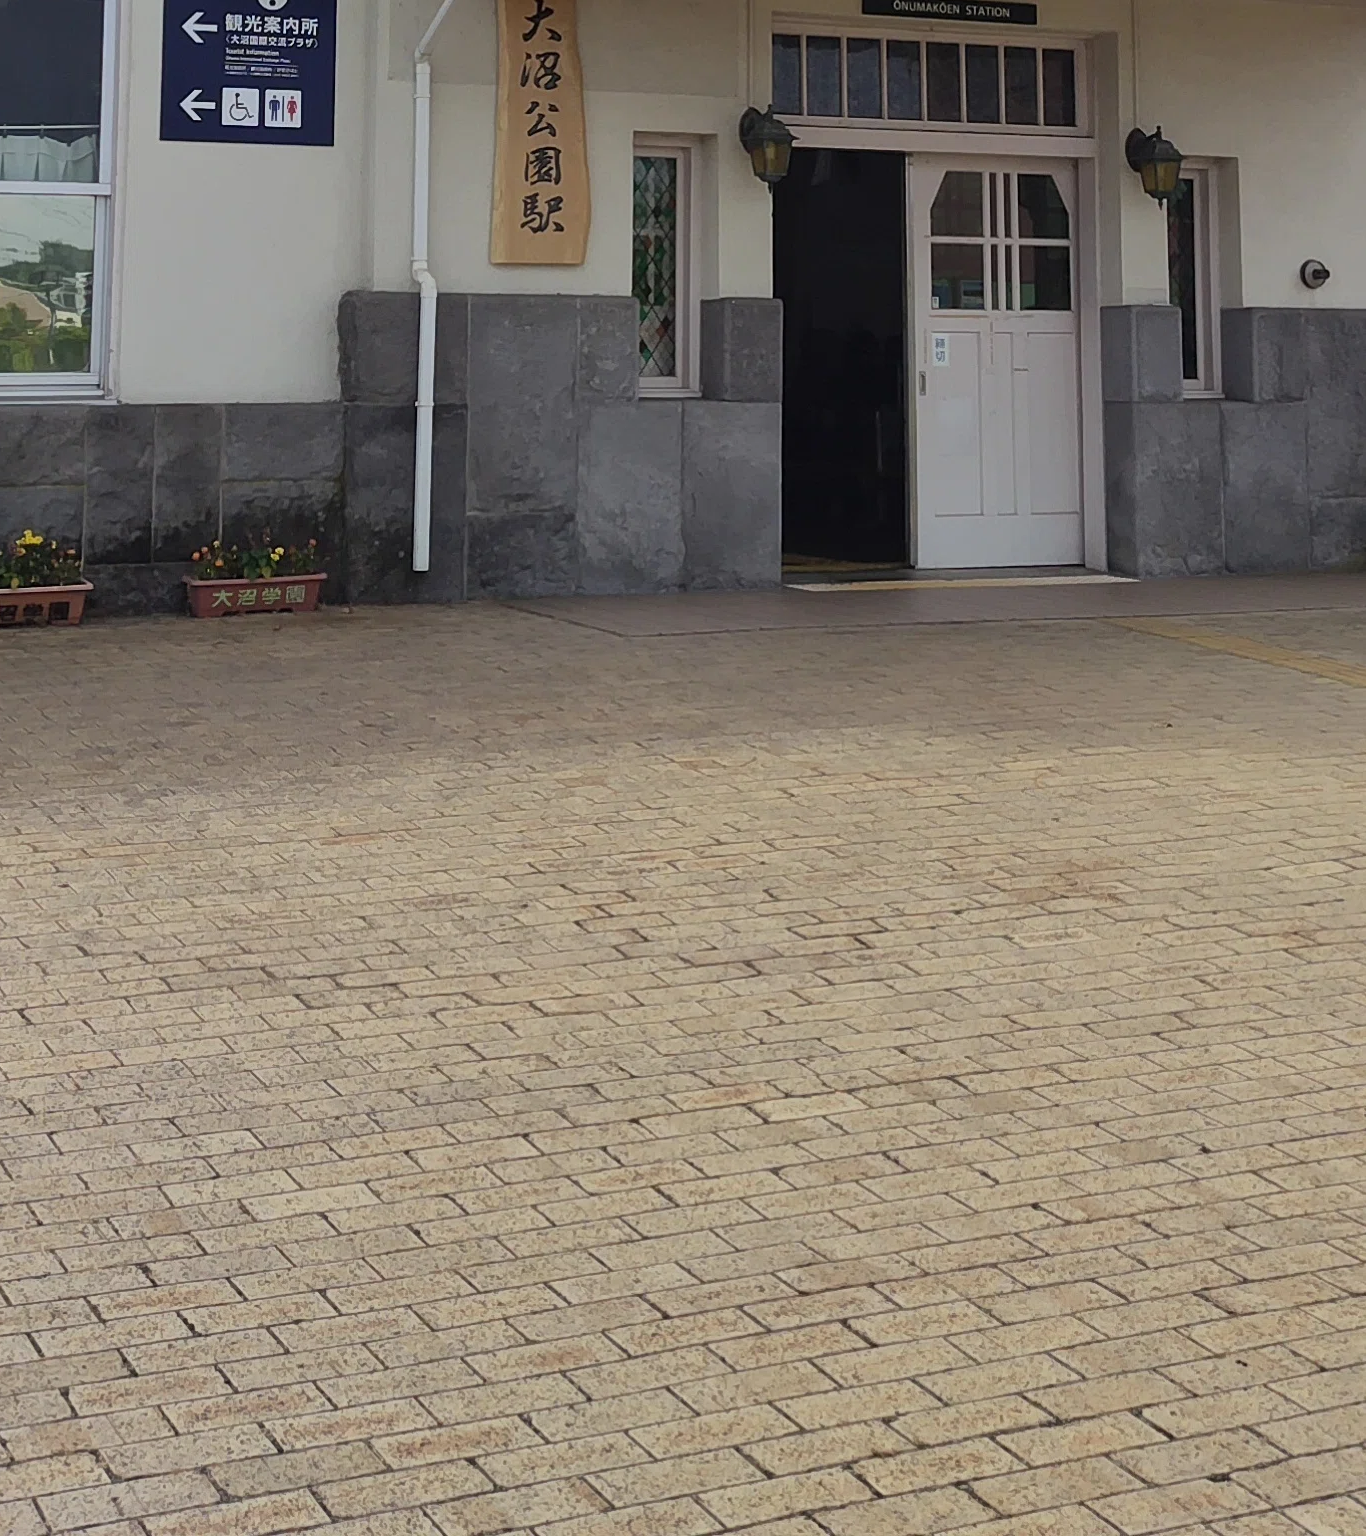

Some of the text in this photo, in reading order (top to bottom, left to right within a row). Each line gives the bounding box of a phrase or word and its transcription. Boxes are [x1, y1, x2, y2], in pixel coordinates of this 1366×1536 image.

[965, 5, 1010, 17] STATION
[225, 13, 319, 36] 観光案内所
[211, 585, 306, 608] 大沼学園
